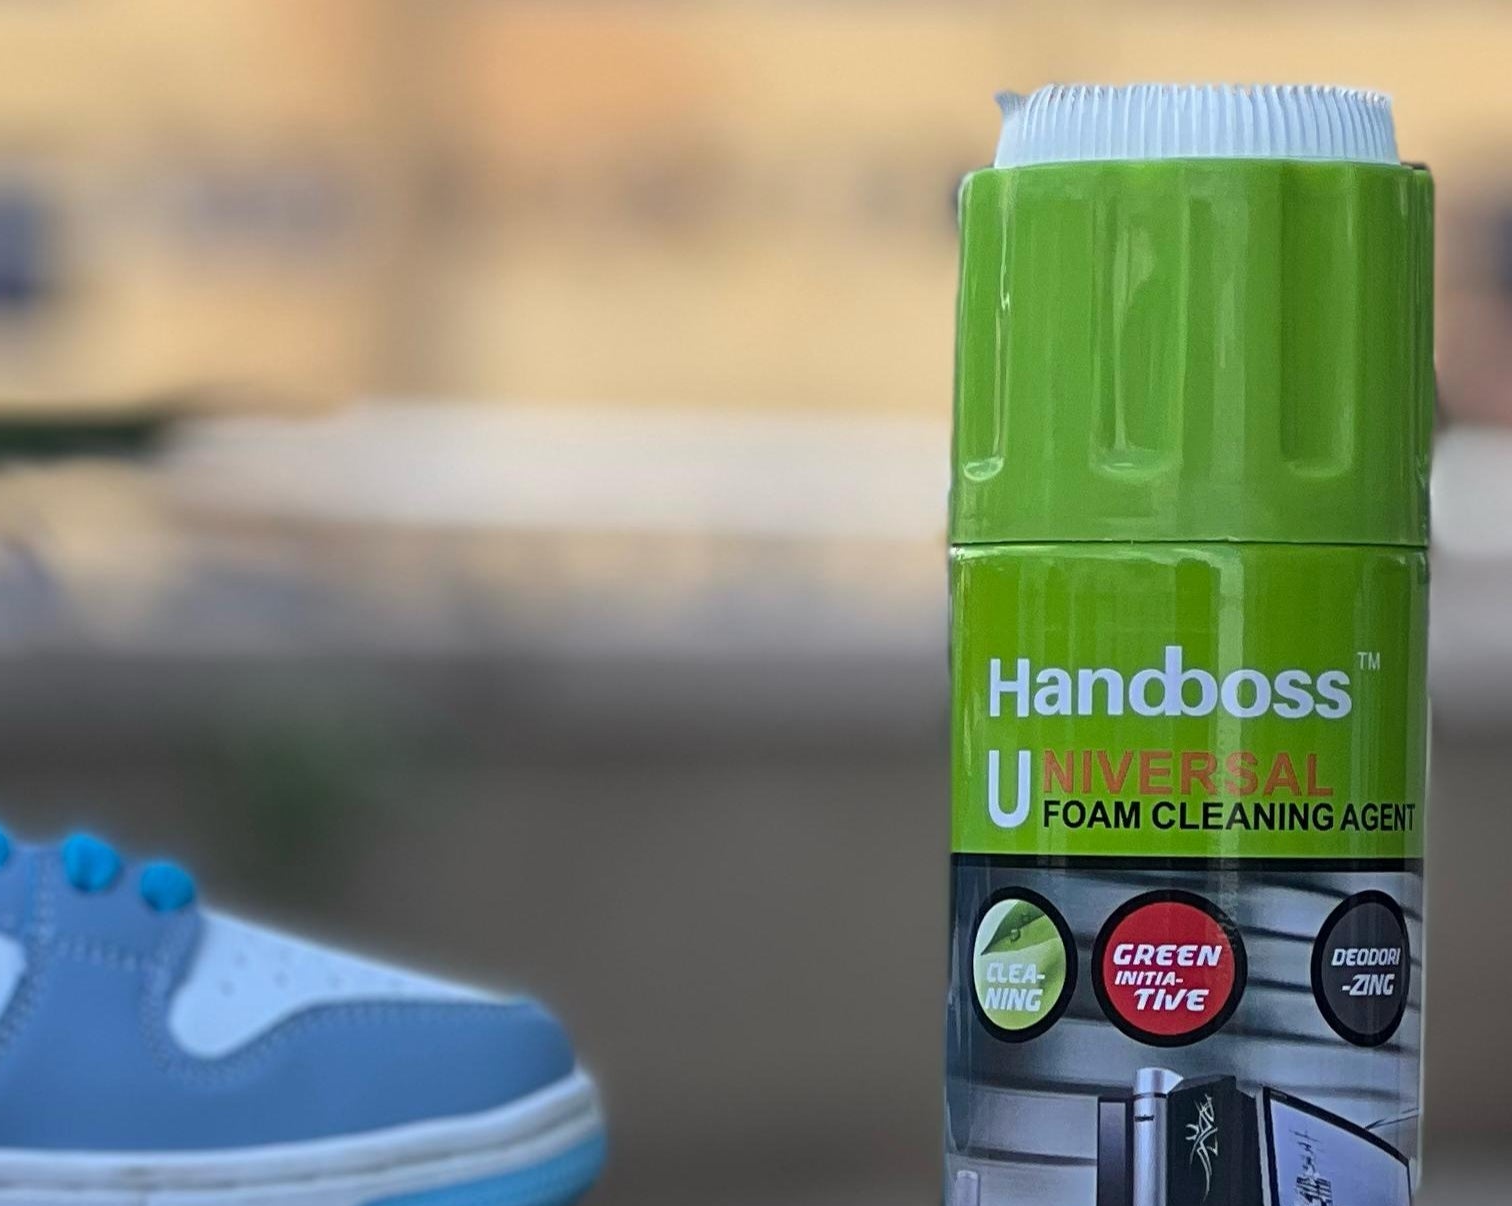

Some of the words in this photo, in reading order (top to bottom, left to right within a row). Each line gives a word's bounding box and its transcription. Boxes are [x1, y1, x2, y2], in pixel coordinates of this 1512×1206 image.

[988, 645, 1353, 719] Handboss
[1043, 800, 1142, 829] FOAM
[1152, 801, 1335, 831] CLEANING
[1340, 802, 1416, 831] AGENT
[1113, 944, 1223, 967] GREEN
[1332, 947, 1402, 966] DEODORI
[984, 988, 1044, 1013] NING
